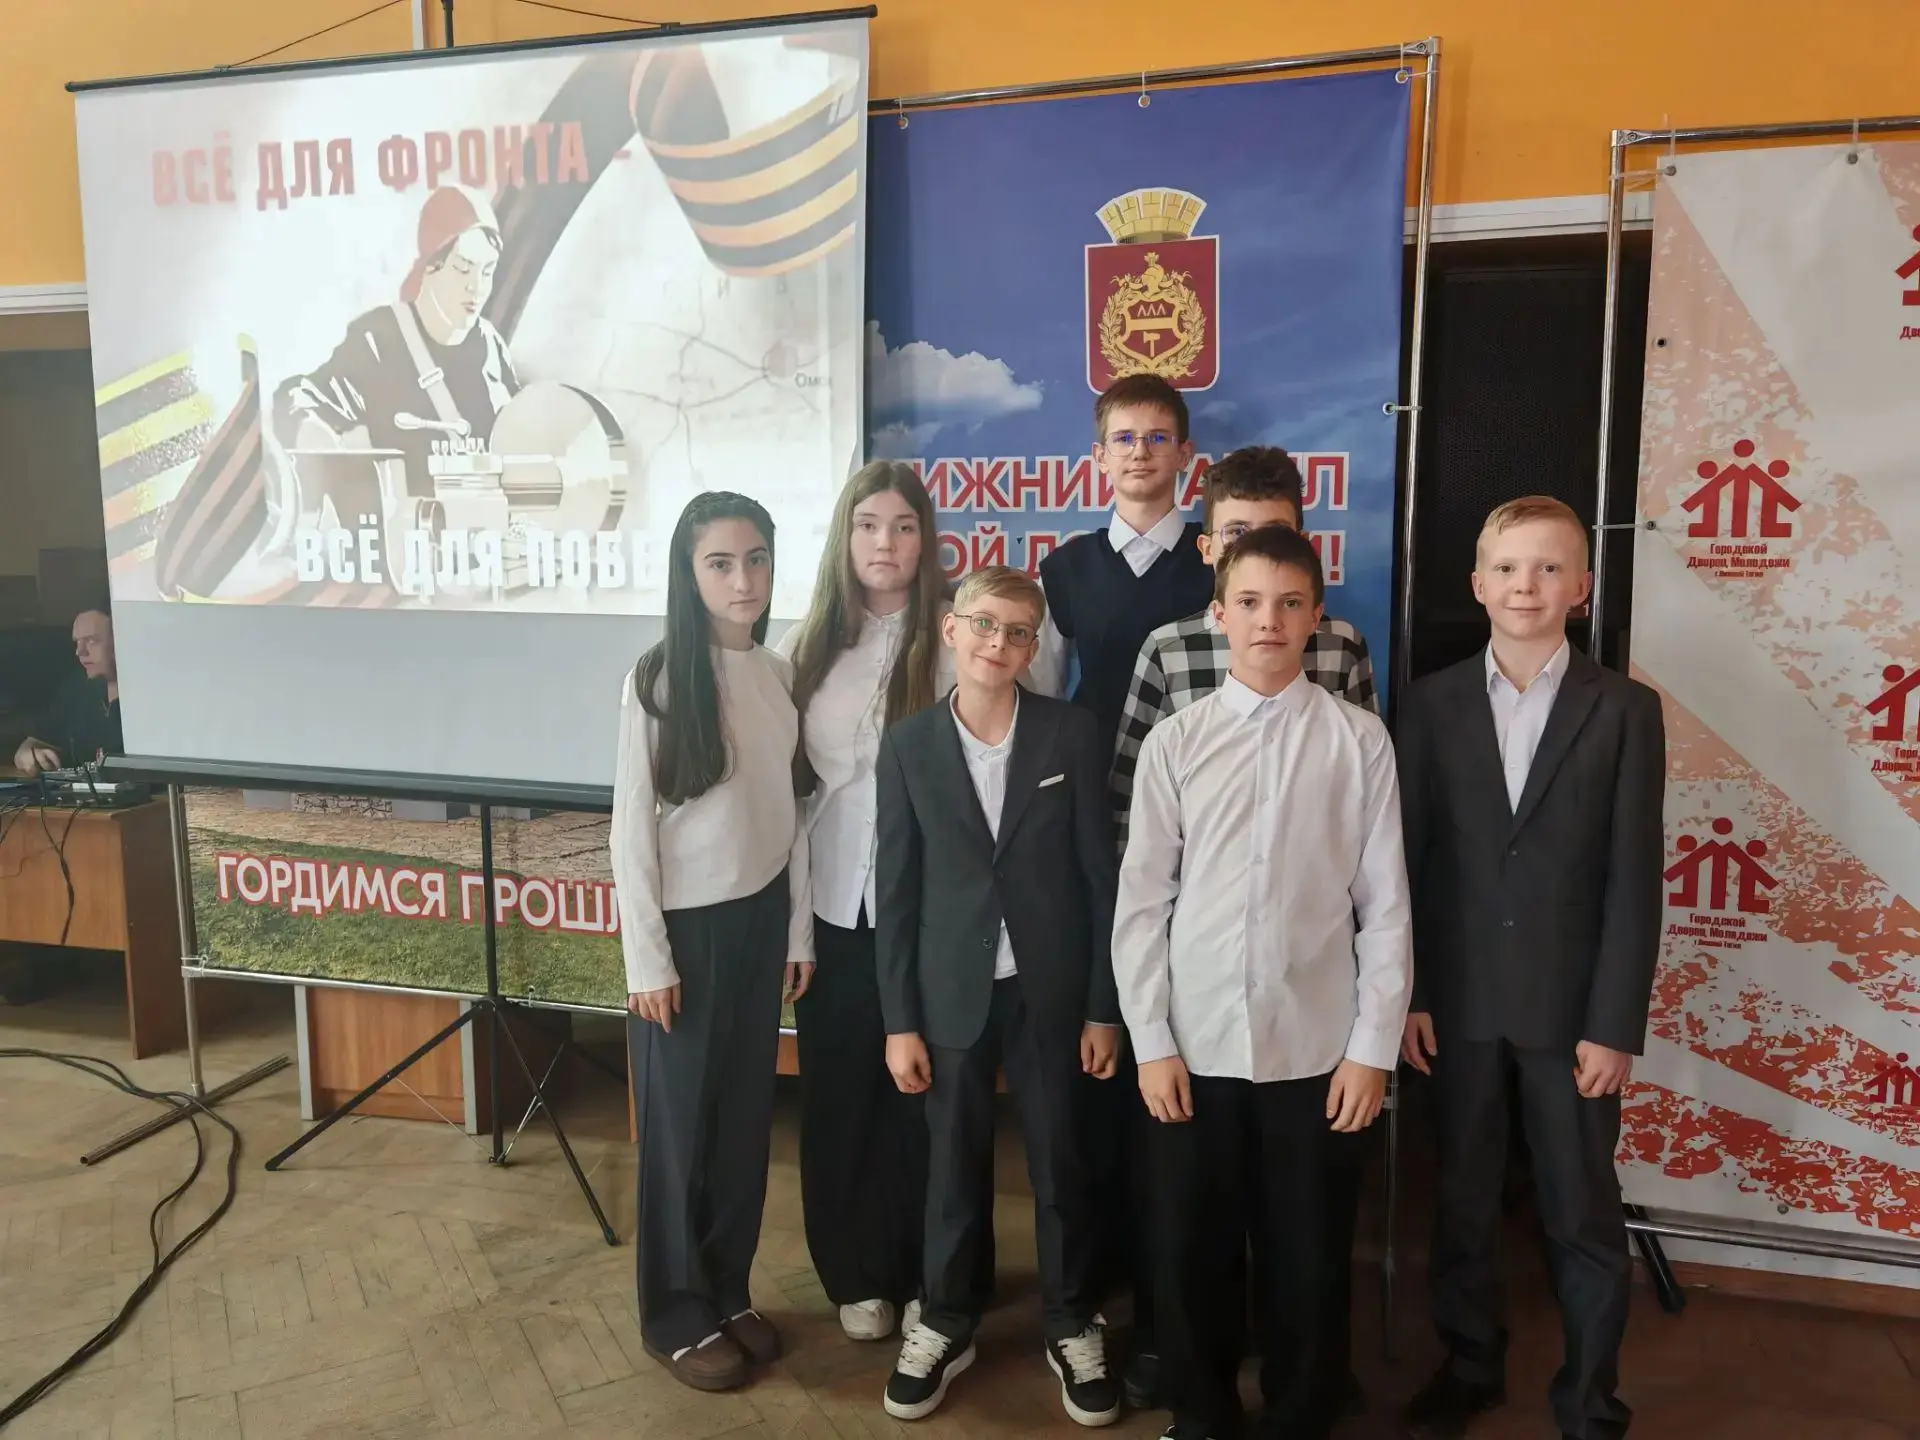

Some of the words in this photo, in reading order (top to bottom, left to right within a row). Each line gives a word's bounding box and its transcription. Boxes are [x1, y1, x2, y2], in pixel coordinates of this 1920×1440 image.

[152, 131, 237, 208] ВСЁ
[256, 137, 355, 211] ДЛЯ
[377, 121, 589, 193] ФРОНТА
[913, 458, 1117, 508] ИЖНИ
[296, 513, 383, 584] ВСЁ
[401, 528, 504, 602] ДЛЯ
[217, 855, 447, 918] ГОРДИМСЯ
